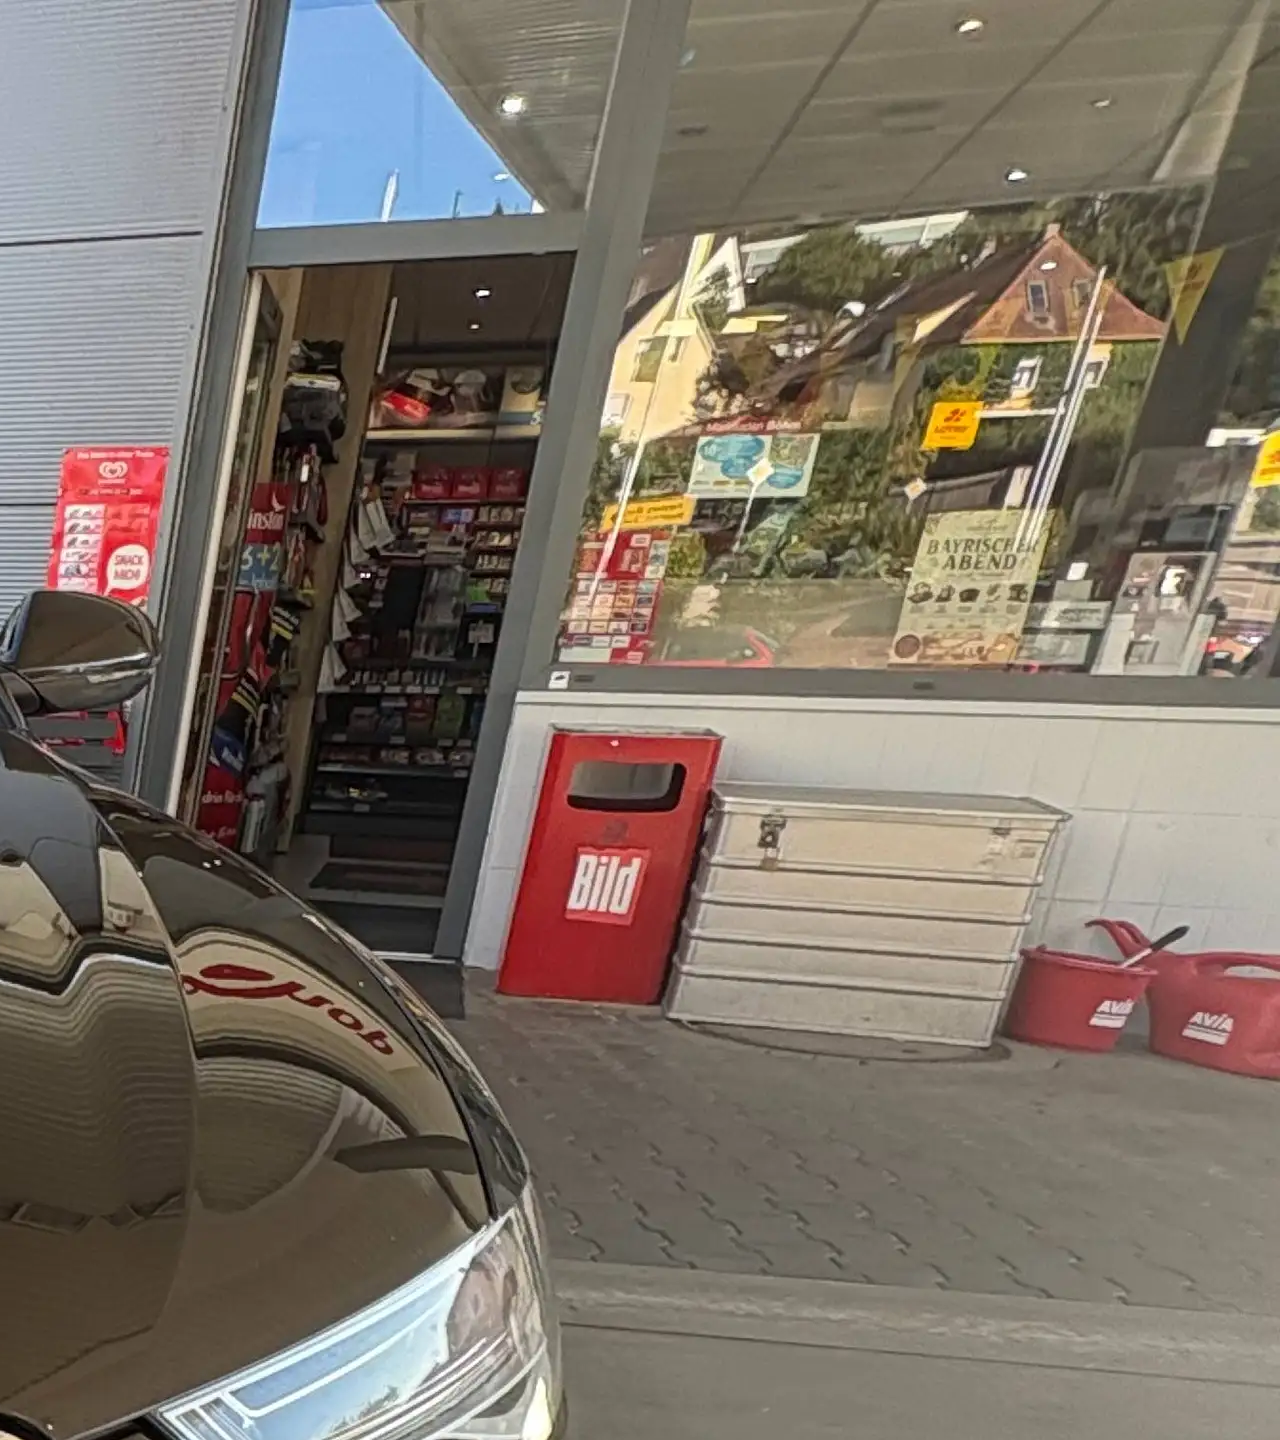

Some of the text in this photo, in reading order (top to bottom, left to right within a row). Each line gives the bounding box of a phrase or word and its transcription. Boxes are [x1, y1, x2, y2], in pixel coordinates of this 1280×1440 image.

[942, 554, 1018, 570] ABEND
[567, 853, 641, 915] Bild
[1188, 1011, 1234, 1033] AVIA
